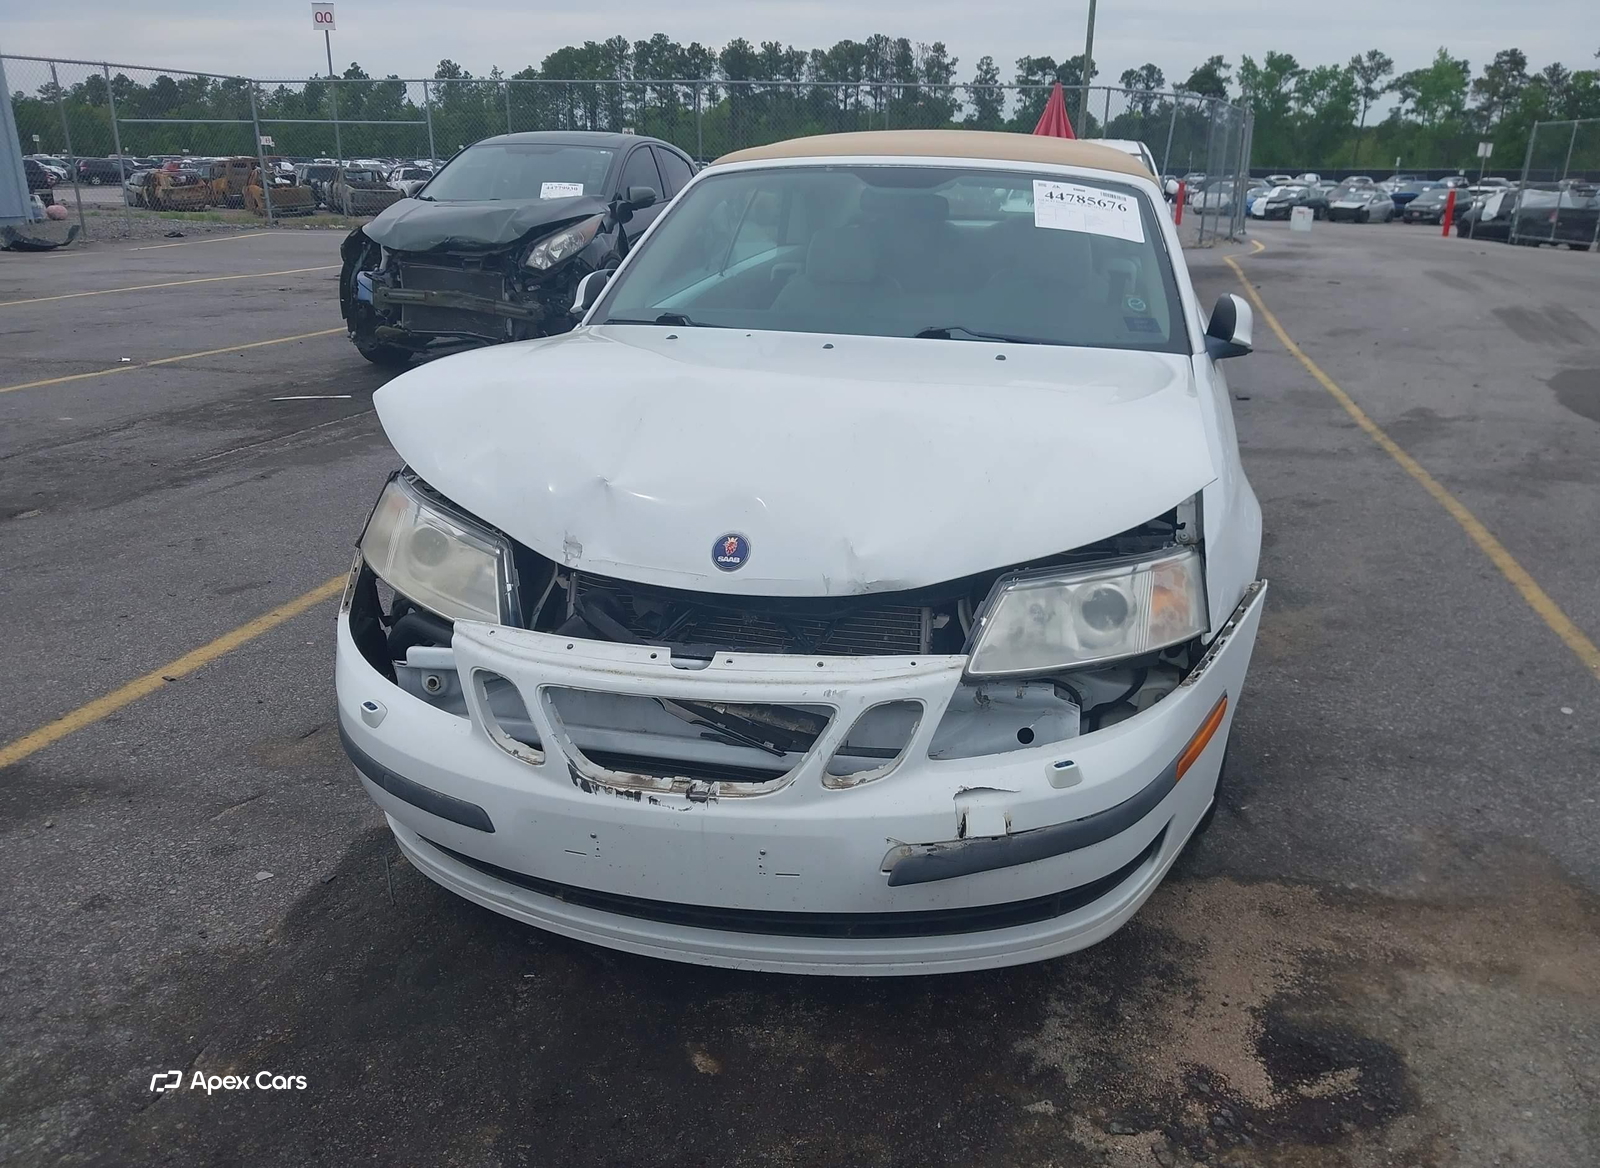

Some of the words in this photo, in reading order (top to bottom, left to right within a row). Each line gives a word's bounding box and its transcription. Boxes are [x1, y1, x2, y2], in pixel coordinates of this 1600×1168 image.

[315, 11, 333, 23] QQ
[1044, 190, 1127, 212] 44785676
[717, 555, 740, 563] SAAB
